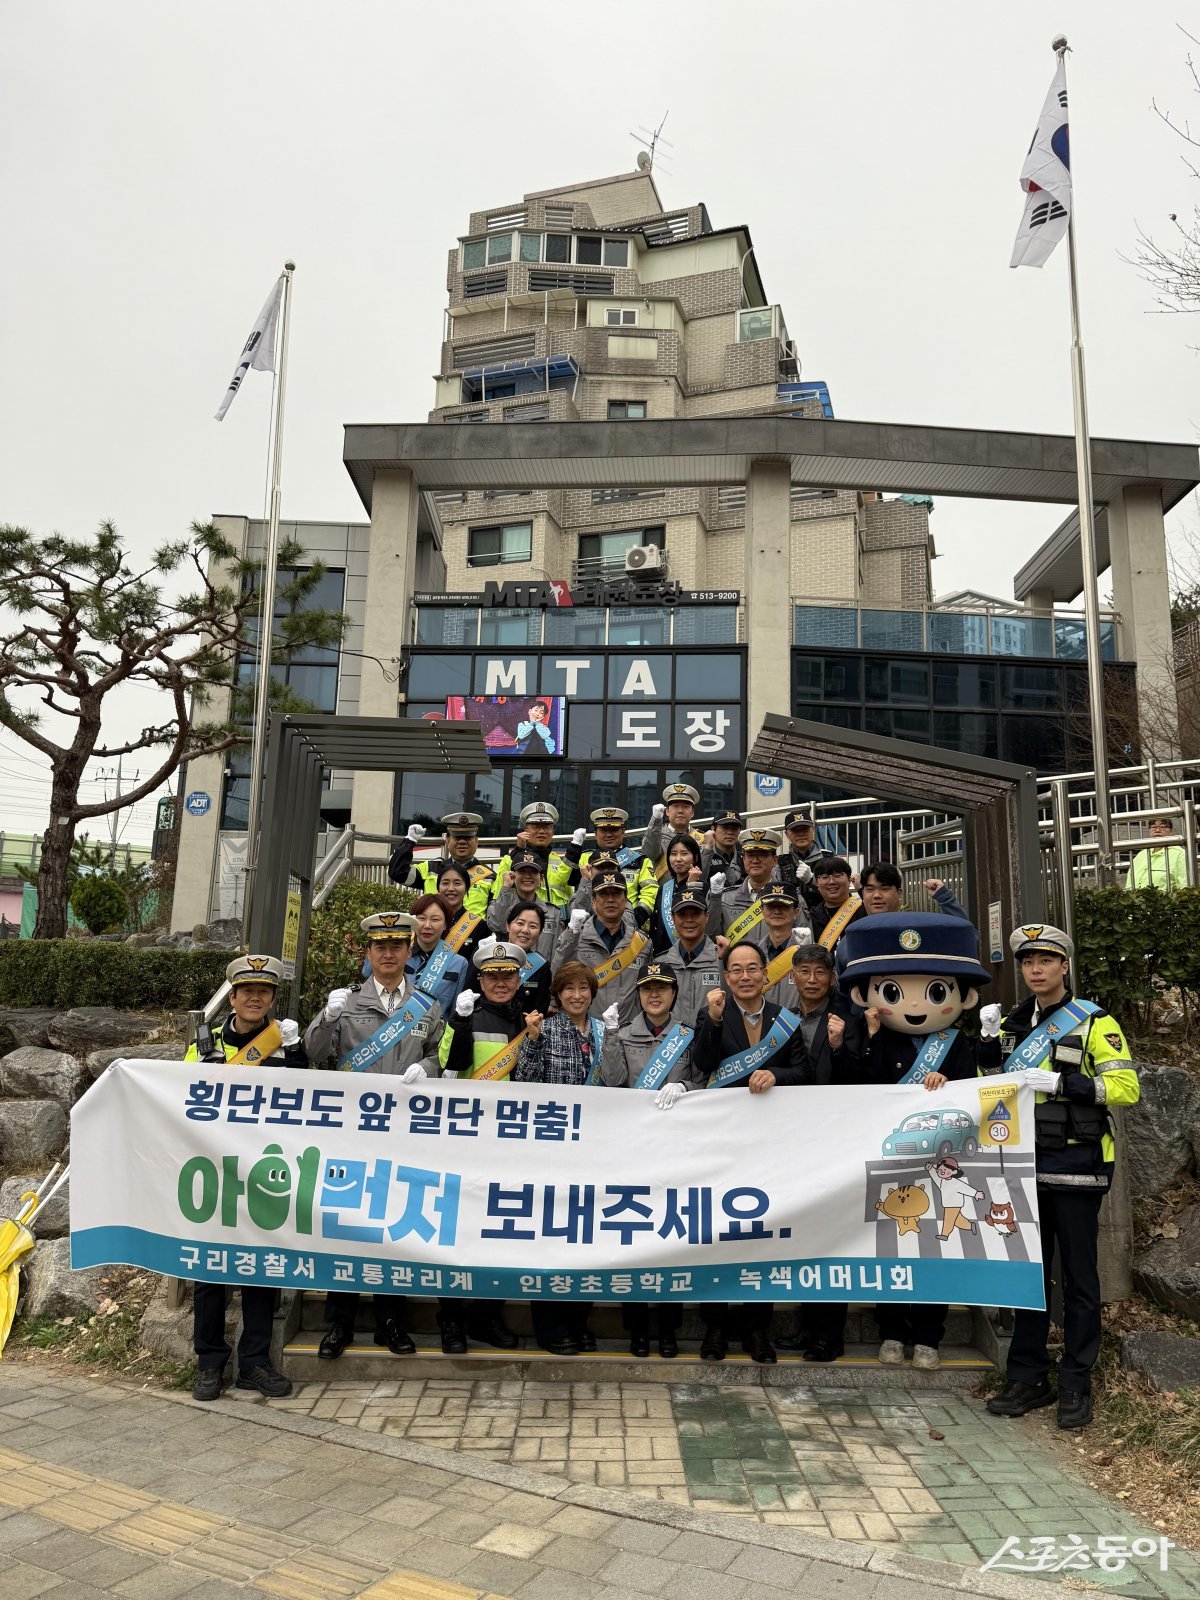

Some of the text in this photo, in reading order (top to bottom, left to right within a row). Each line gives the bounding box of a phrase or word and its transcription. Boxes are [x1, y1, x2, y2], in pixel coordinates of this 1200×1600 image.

[485, 581, 573, 606] MTA
[699, 592, 738, 600] 513-9200
[486, 660, 656, 695] MTA
[616, 710, 731, 753] 도장
[759, 777, 779, 786] ADT
[189, 799, 207, 808] ADT
[421, 951, 448, 991] 사람이 보이
[379, 1021, 405, 1047] 사람이
[661, 1036, 684, 1061] 사람이
[744, 1045, 769, 1067] 사람이
[924, 1040, 944, 1066] 사람이
[1021, 1034, 1050, 1063] 사람이
[186, 1081, 581, 1141] 횡단보도 앞 일단 멈춤!
[992, 1126, 1006, 1137] 30
[481, 1184, 793, 1245] 보내주세요.
[180, 1246, 913, 1294] 구리경찰서 교통관리계 인창초등학교 녹색어머니회
